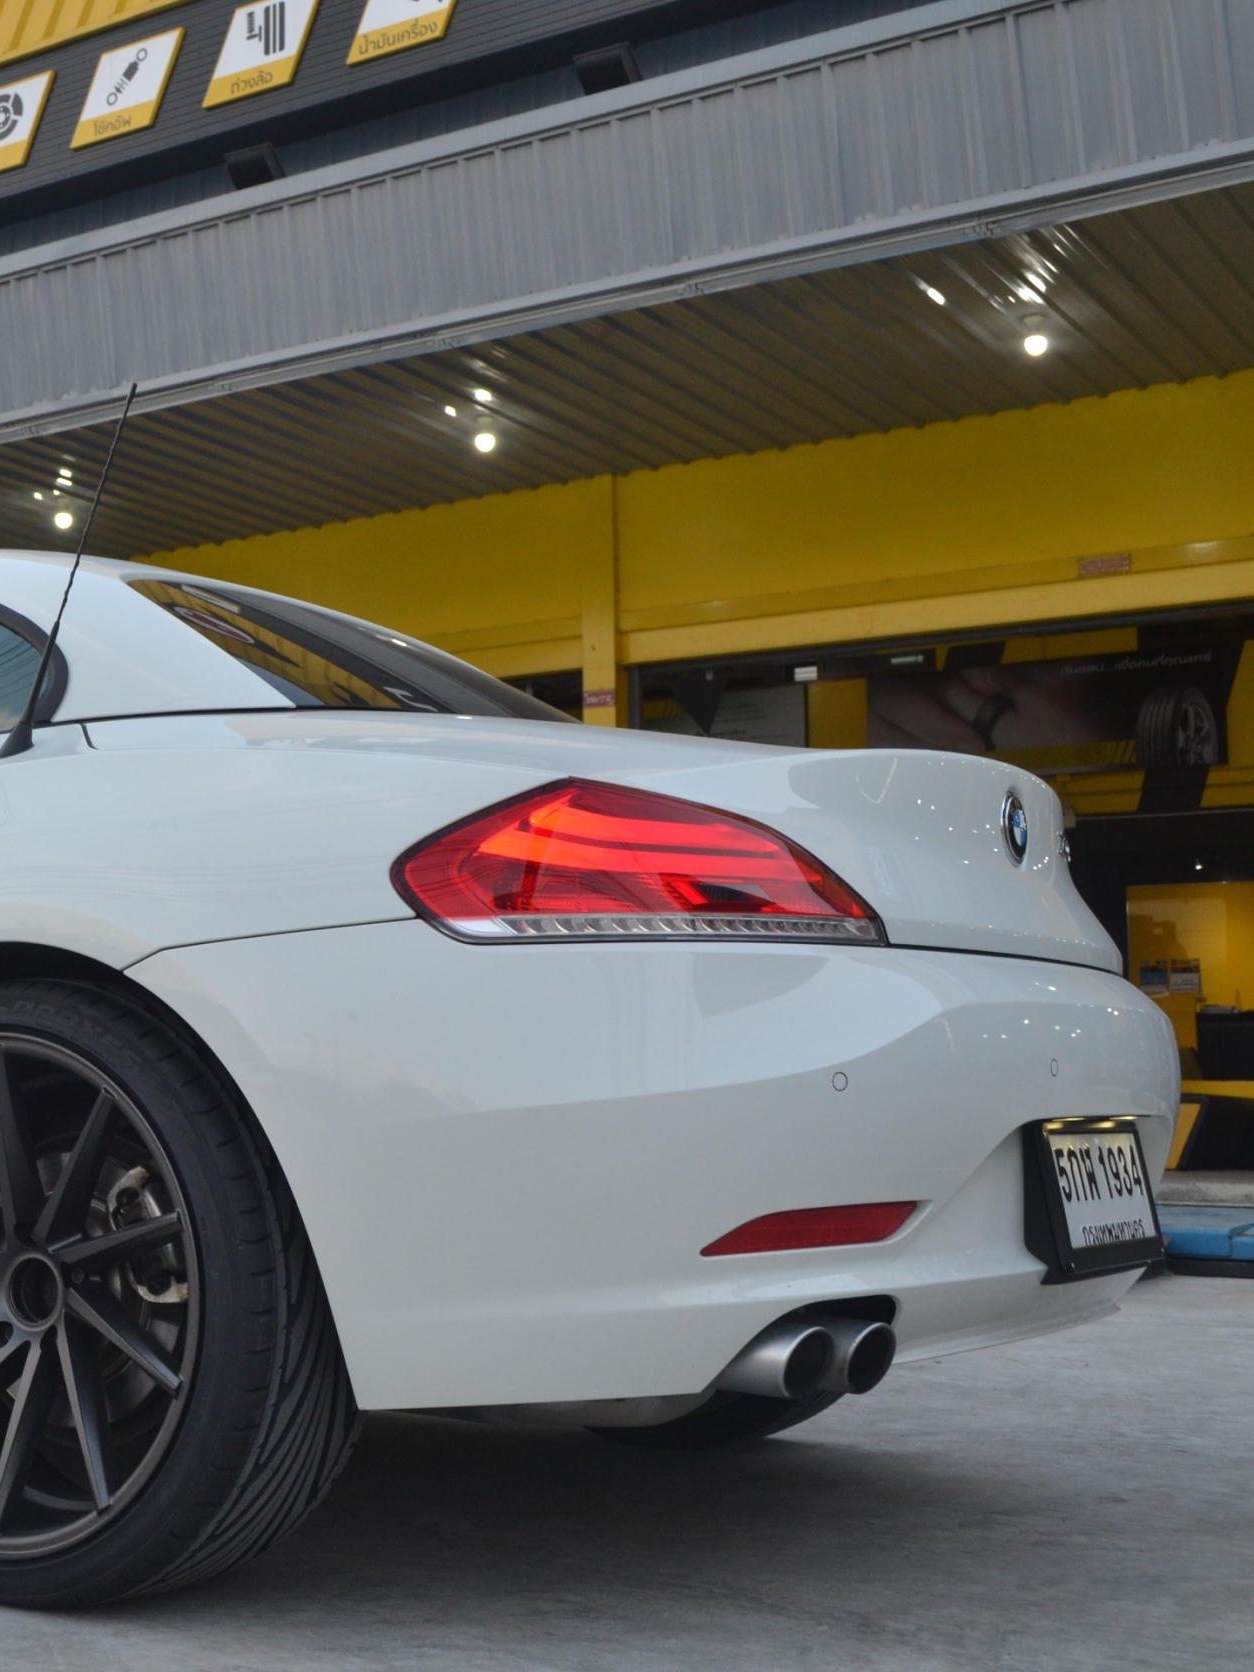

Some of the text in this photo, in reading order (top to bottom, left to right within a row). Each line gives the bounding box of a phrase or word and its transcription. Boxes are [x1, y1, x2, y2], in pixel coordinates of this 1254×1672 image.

[358, 17, 438, 56] น้ำมันเครื่อง
[230, 71, 274, 95] ถ่วงล้อ
[1098, 1145, 1144, 1199] 1934
[1082, 1219, 1146, 1247] กรงเทพมหานคร
